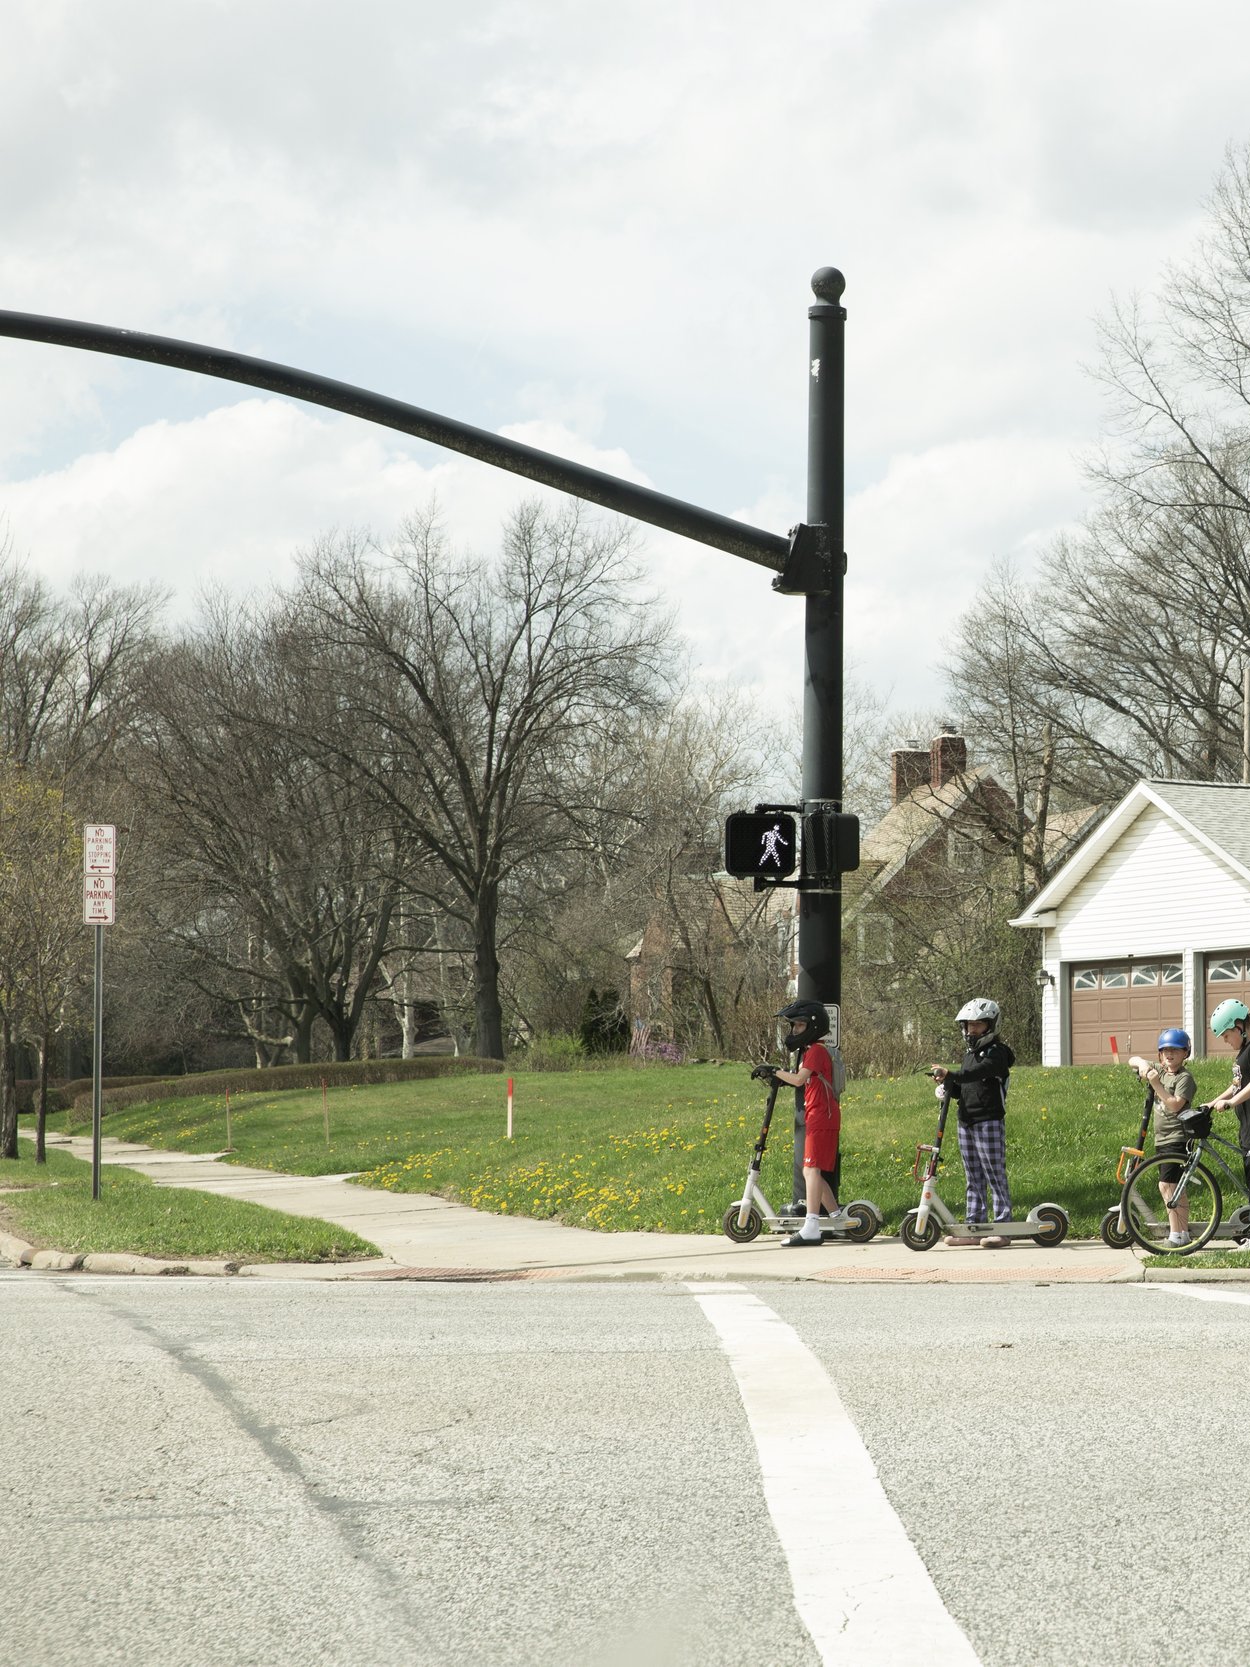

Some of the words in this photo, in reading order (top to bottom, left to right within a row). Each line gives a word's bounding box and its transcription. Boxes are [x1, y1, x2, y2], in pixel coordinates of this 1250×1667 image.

[95, 829, 105, 837] NO
[93, 880, 105, 889] NO
[86, 891, 112, 899] PARKING
